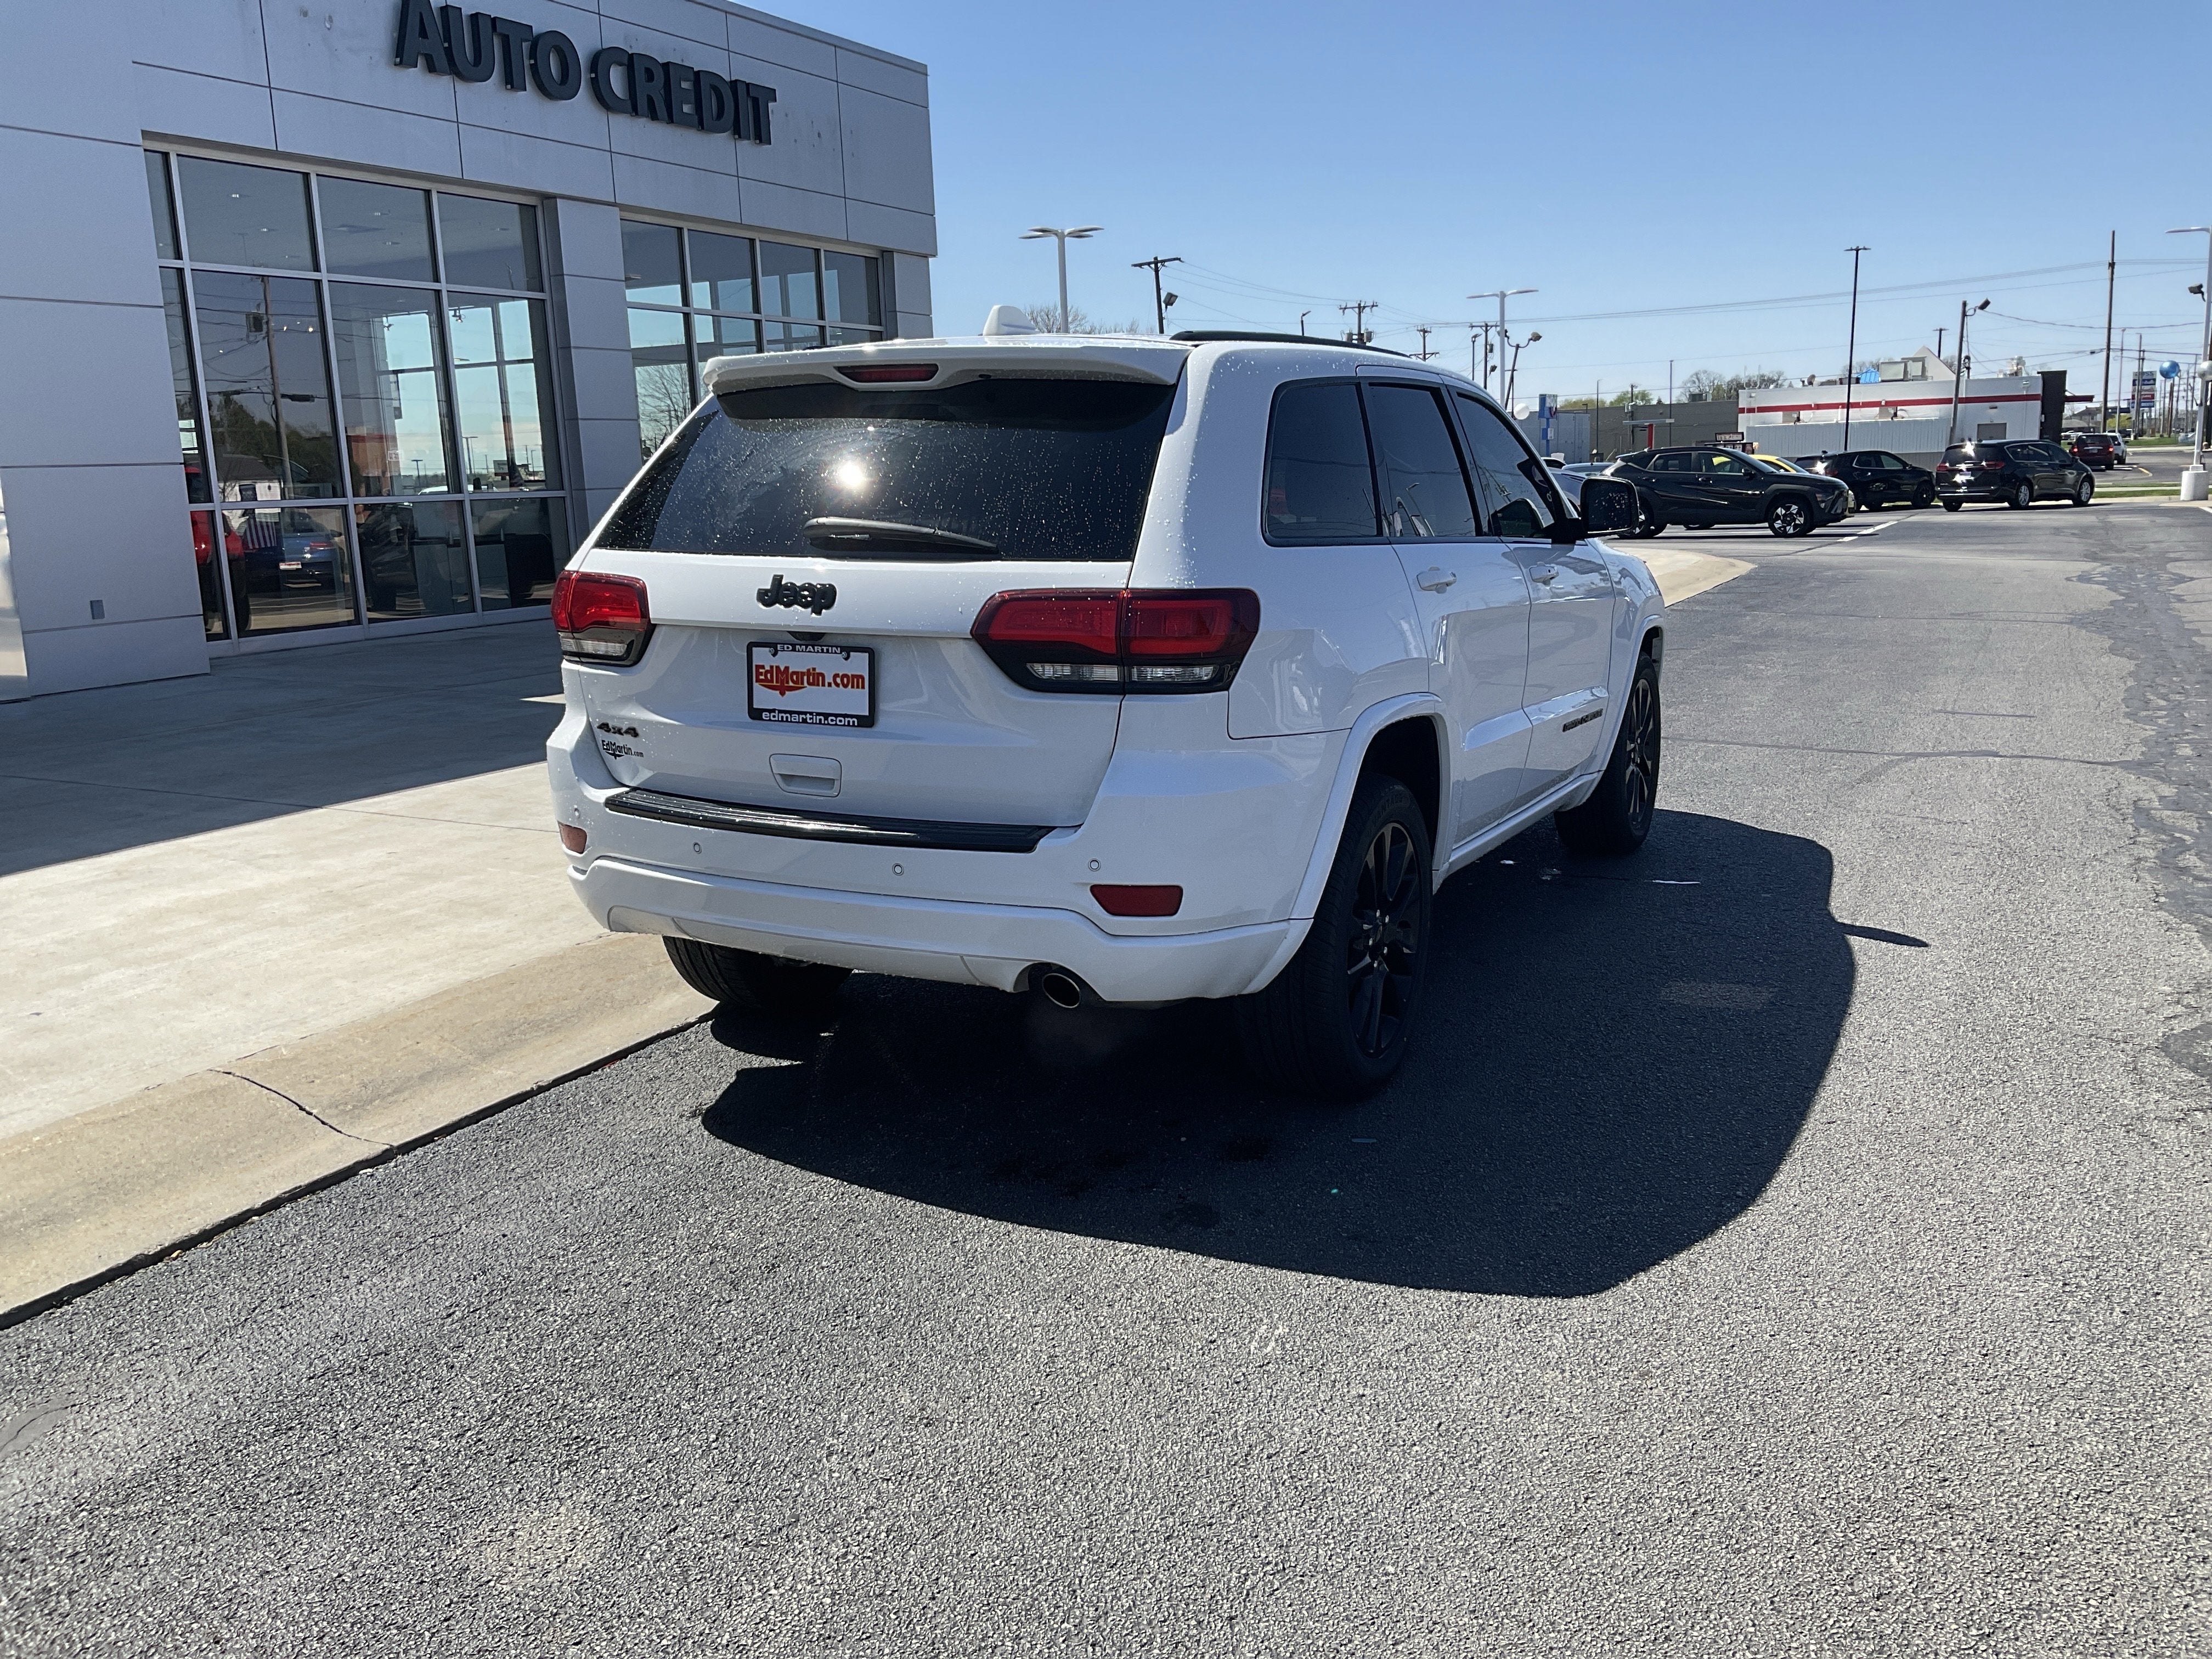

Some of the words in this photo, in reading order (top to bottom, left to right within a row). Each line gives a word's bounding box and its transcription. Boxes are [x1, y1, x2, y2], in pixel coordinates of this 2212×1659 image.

[393, 0, 582, 101] AUTO
[590, 46, 777, 146] CREDIT
[756, 574, 837, 616] Jeep
[795, 645, 841, 654] MARTIN
[754, 664, 866, 690] EdMartin.com
[761, 710, 858, 726] edmartin.com
[596, 721, 639, 738] 4x4
